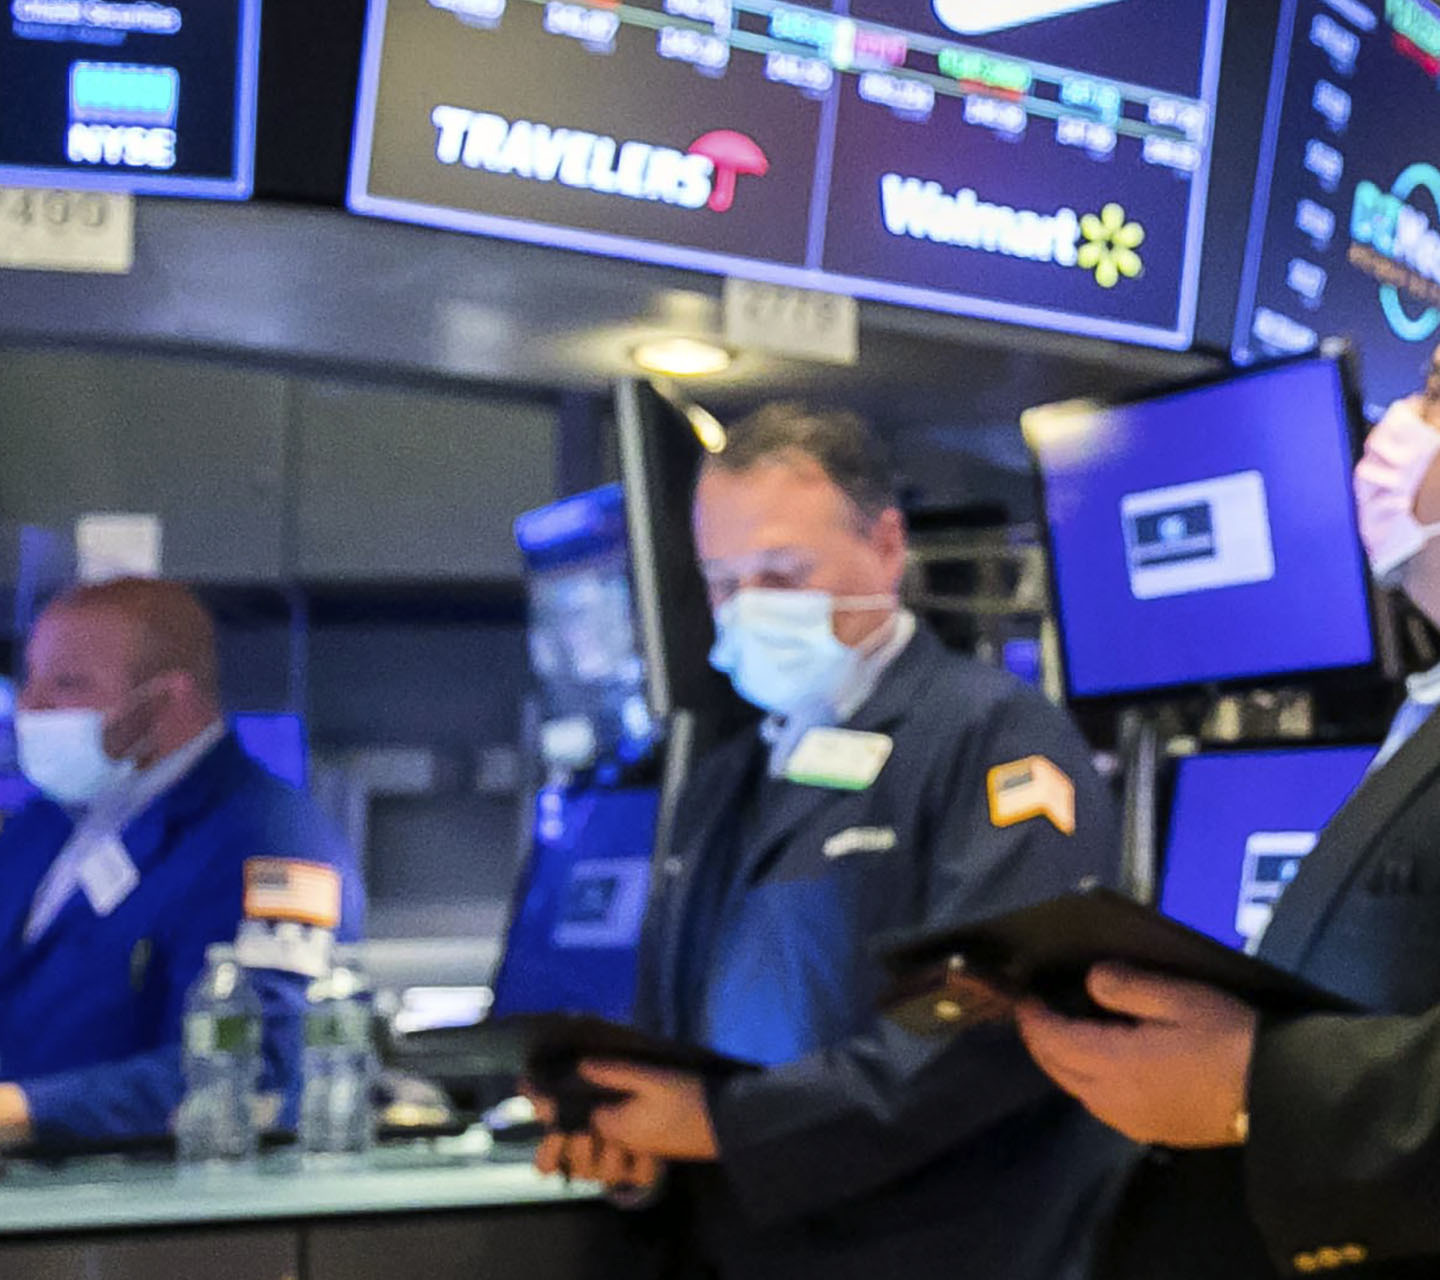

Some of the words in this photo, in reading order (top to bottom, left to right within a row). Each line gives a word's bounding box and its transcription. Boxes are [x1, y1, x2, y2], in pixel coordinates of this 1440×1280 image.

[67, 122, 177, 170] NYSE
[432, 104, 715, 209] TRAVELERS
[881, 172, 1080, 268] Walmart
